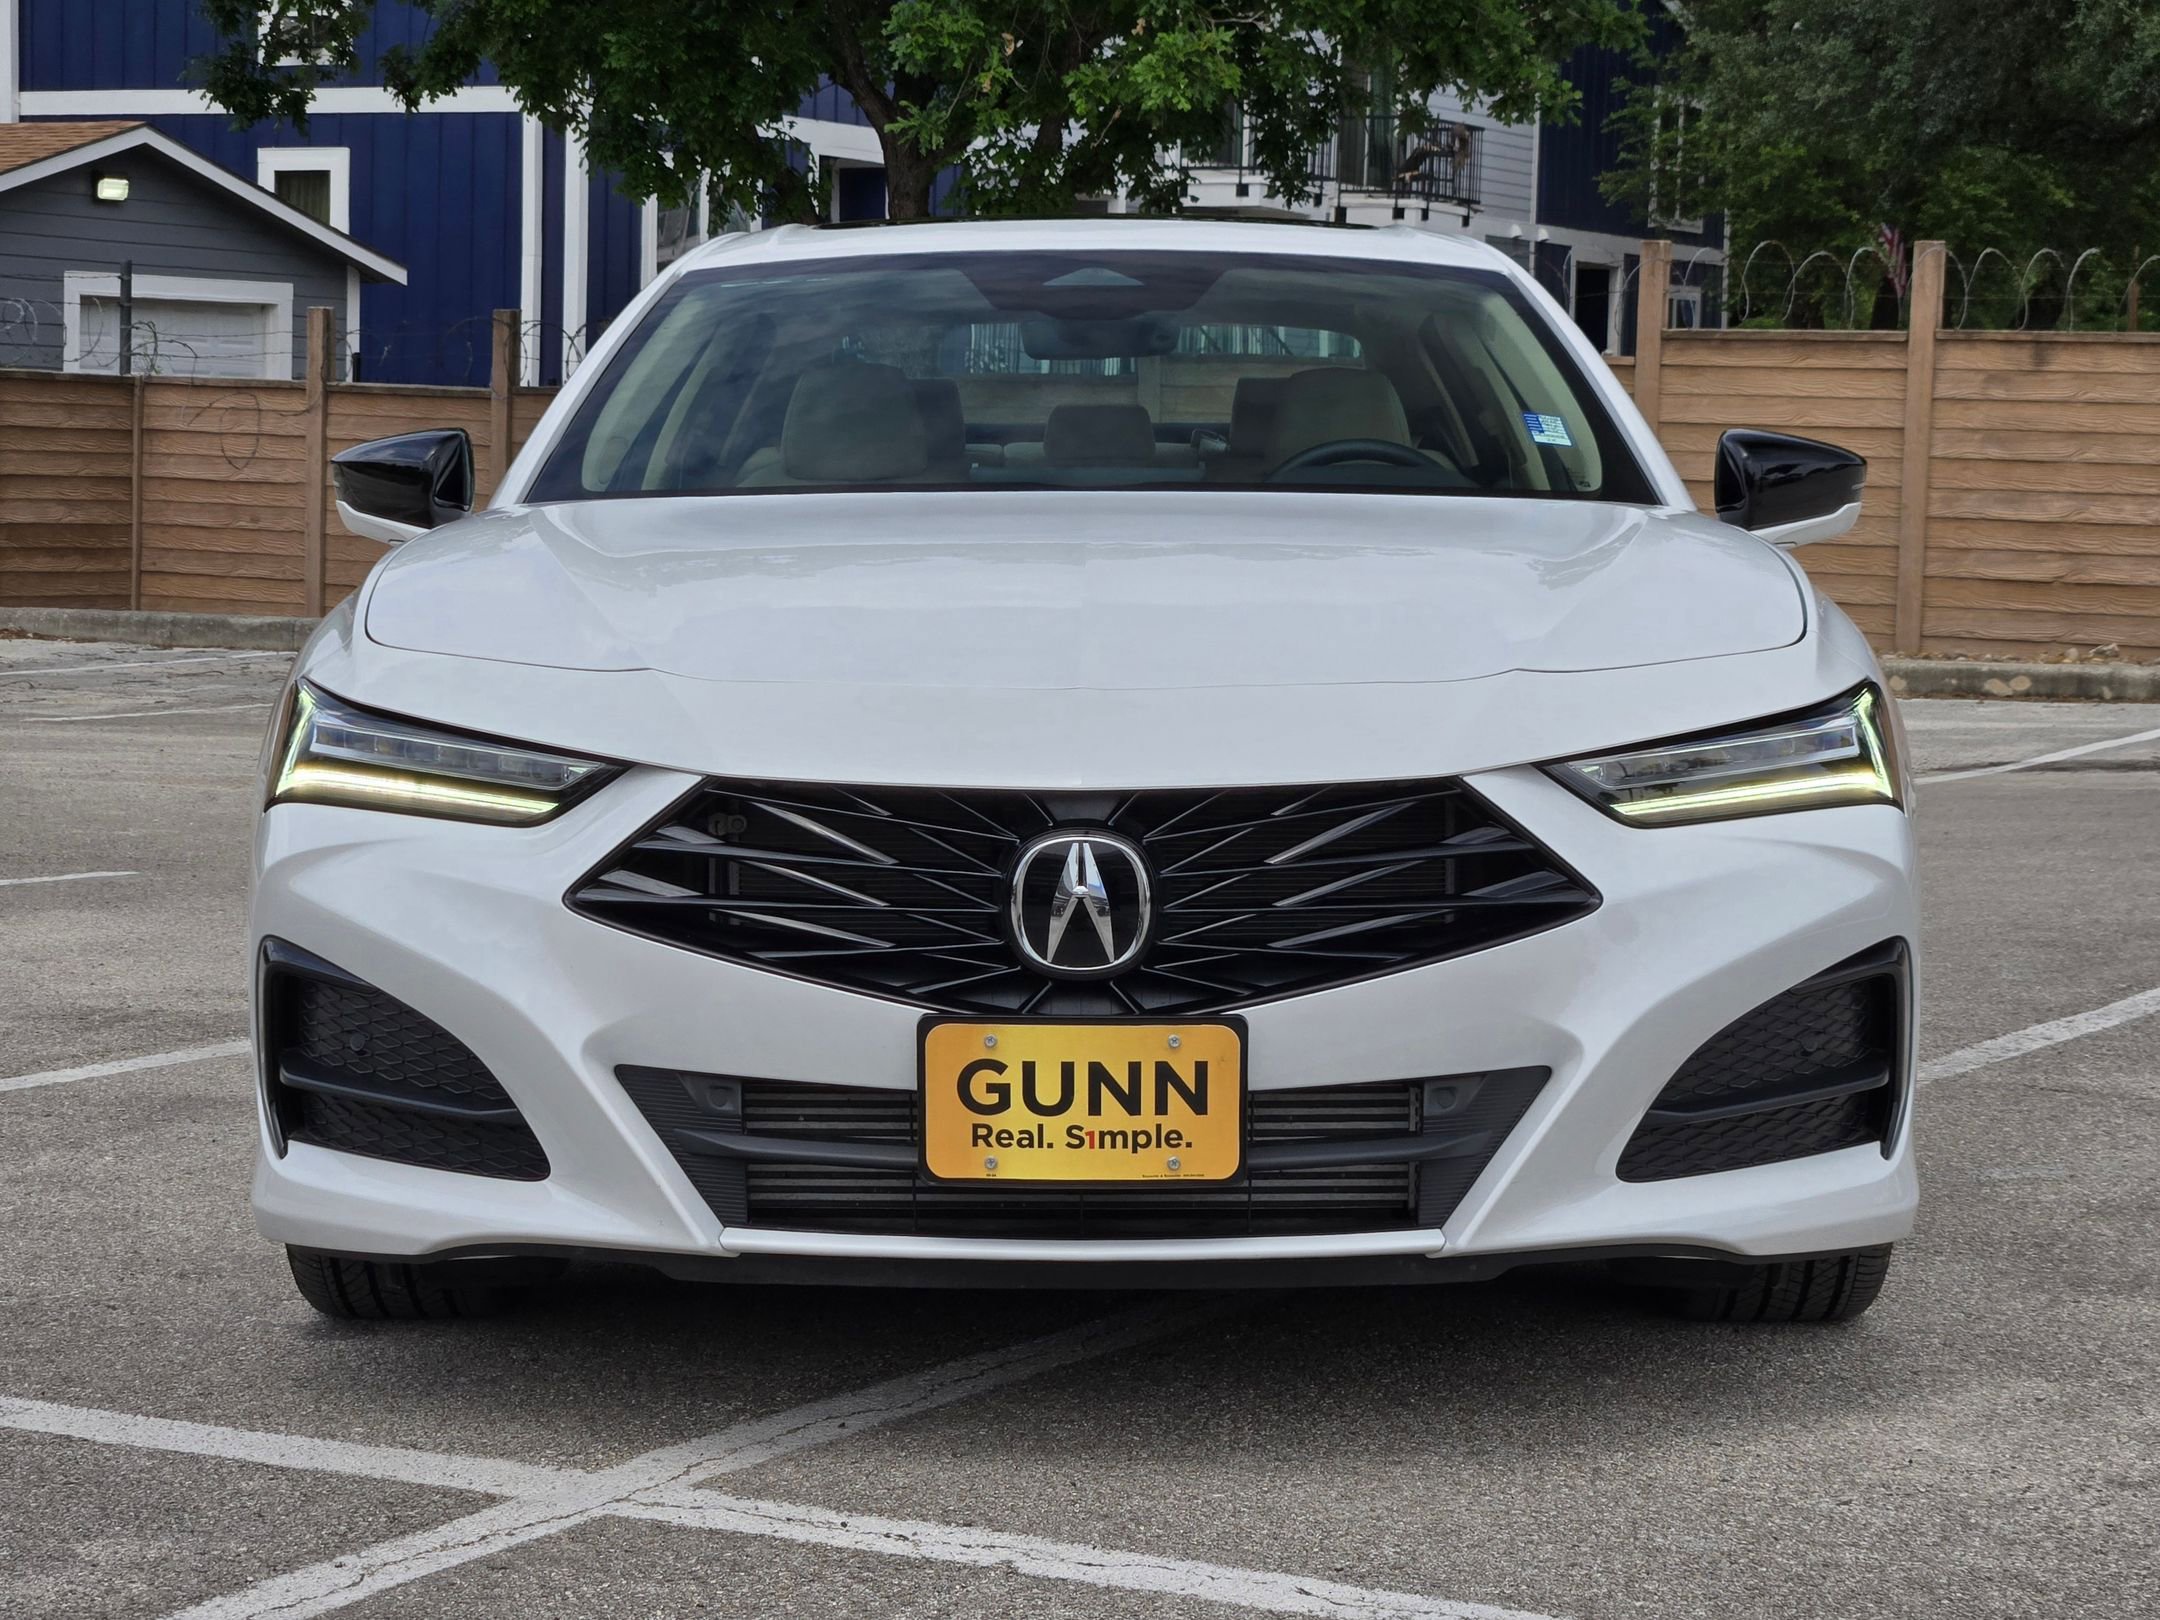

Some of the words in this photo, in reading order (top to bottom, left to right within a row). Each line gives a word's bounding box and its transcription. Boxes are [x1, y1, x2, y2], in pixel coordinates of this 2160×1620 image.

[957, 1058, 1208, 1117] GUNN
[972, 1123, 1054, 1149] Real.
[1065, 1123, 1193, 1154] S1mple.
